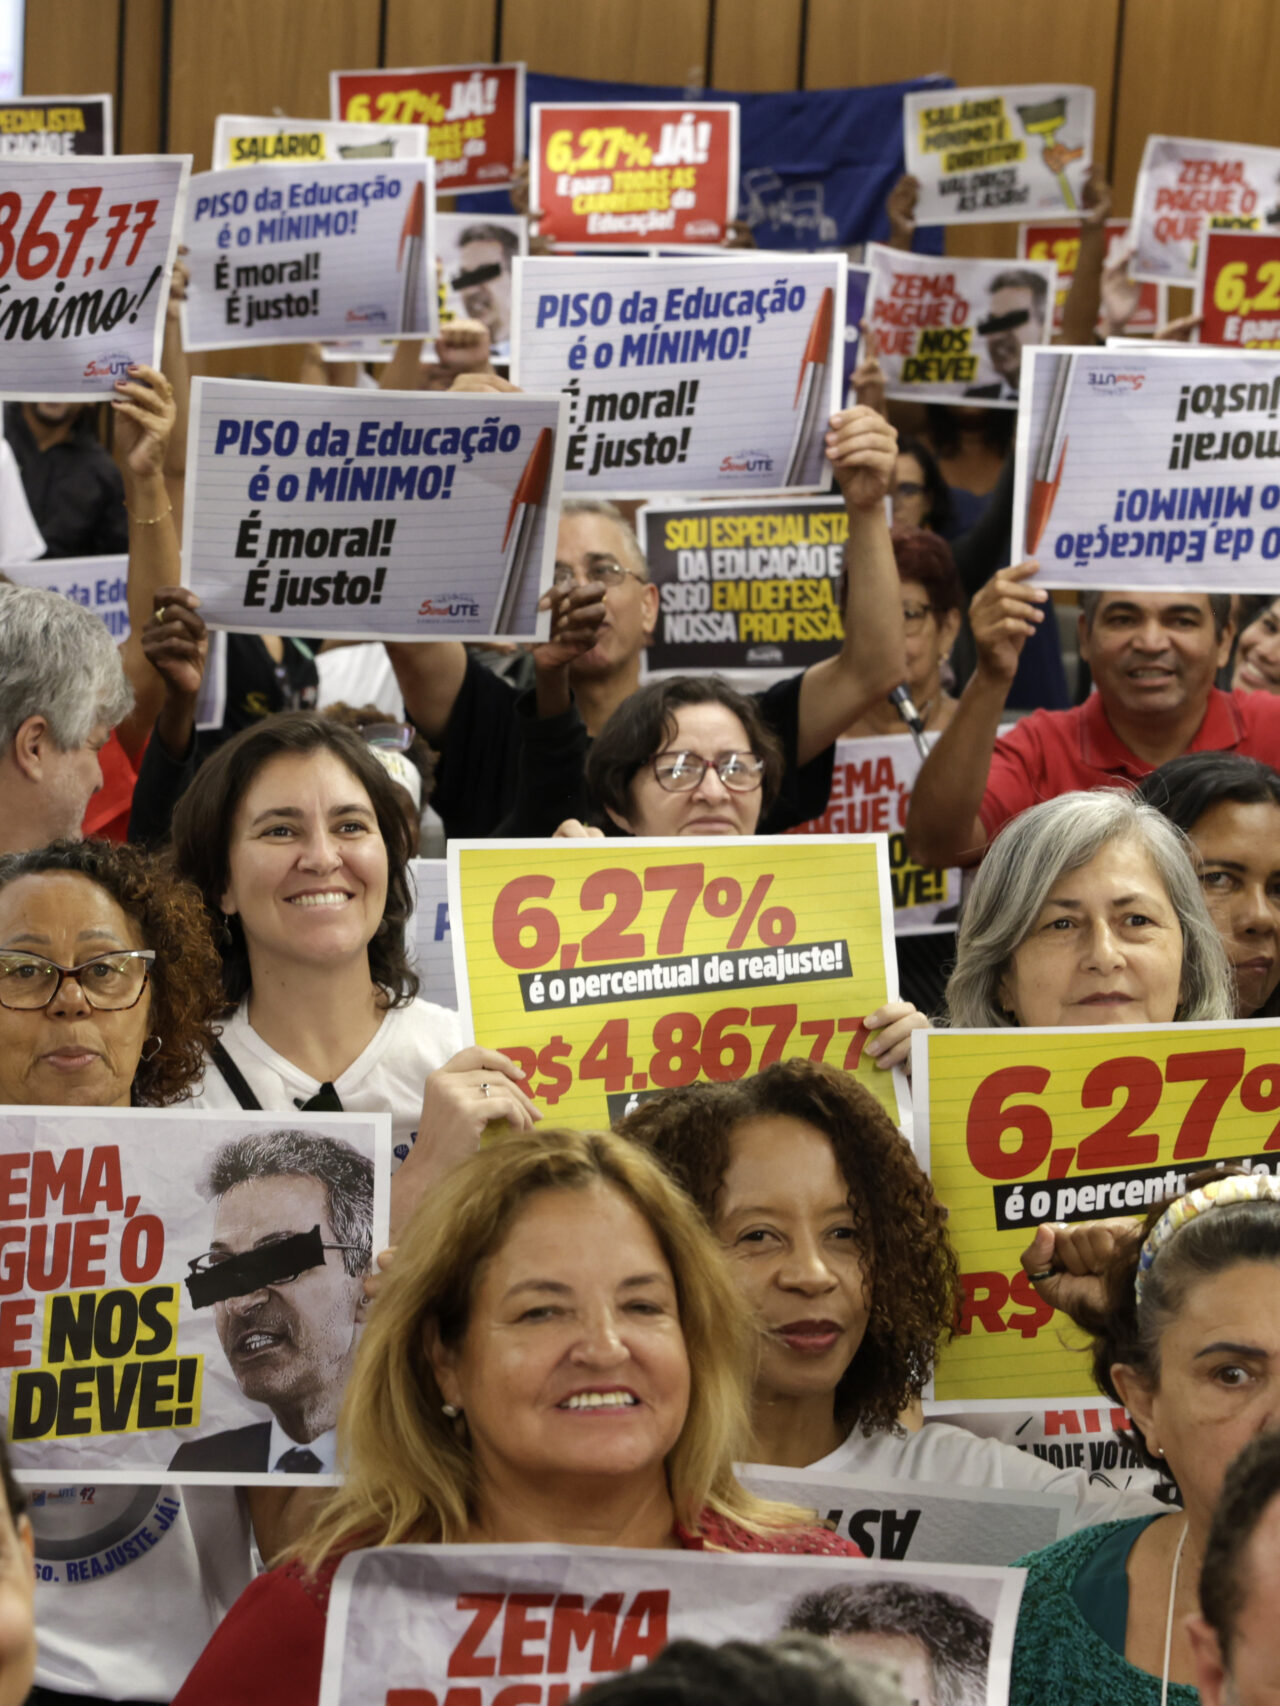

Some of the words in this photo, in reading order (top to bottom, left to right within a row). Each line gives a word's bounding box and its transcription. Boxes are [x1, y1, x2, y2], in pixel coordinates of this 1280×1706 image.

[545, 127, 651, 174] 6,27%
[653, 114, 711, 166] JÁ!
[194, 190, 249, 221] PISO
[254, 186, 282, 213] da
[289, 175, 401, 209] Educação
[1155, 188, 1230, 212] PAGUE
[218, 223, 231, 248] é
[237, 227, 251, 246] o
[257, 208, 358, 245] MÍNIMO!
[1154, 217, 1201, 243] QUE
[214, 255, 228, 290] É
[236, 252, 320, 288] moral!
[891, 273, 961, 300] ZEMA,
[1214, 262, 1280, 315] 6,2
[226, 292, 241, 324] É
[245, 289, 319, 328] justo!
[536, 292, 612, 328] PISO
[620, 291, 658, 324] da
[664, 278, 806, 323] Educação
[873, 300, 949, 327] PAGUE
[568, 336, 587, 370] é
[594, 343, 613, 369] o
[619, 324, 751, 367] MÍNIMO!
[921, 329, 969, 354] NOS
[902, 357, 977, 382] DEVE!
[584, 380, 699, 423] moral!
[215, 419, 299, 456] PISO
[306, 422, 350, 457] da
[356, 416, 521, 463] Educação
[565, 426, 587, 471] É
[589, 427, 691, 476] justo!
[249, 465, 269, 501] é
[277, 473, 299, 501] o
[306, 458, 456, 502] MÍNIMO!
[1114, 486, 1253, 528] MÍNIMO!
[235, 510, 262, 559] É
[266, 518, 396, 558] moral!
[665, 517, 708, 550] SOU
[1055, 524, 1207, 567] Educação
[1214, 527, 1254, 561] da
[678, 550, 710, 581] DA
[712, 541, 825, 581] EDUCAÇÃO
[827, 547, 842, 576] E
[244, 560, 269, 607] É
[270, 567, 387, 613] justo!
[662, 584, 710, 611] SIGO
[713, 582, 748, 611] EM
[751, 579, 834, 610] DEFESA
[665, 615, 737, 644] NOSSA
[739, 605, 845, 642] PROFISSÃ
[832, 756, 904, 801] EMA,
[892, 868, 945, 907] VE!
[493, 862, 796, 970] 6,27%
[529, 973, 545, 1003] é
[550, 978, 566, 1002] o
[570, 957, 699, 1004] percentual
[705, 954, 732, 983] de
[738, 942, 843, 983] reajuste!
[1005, 1185, 1024, 1221] é
[1030, 1194, 1050, 1218] o
[120, 1215, 164, 1283] O
[48, 1286, 174, 1362] NOS
[12, 1358, 198, 1440] DEVE!
[66, 1527, 158, 1583] REAJUSTE
[154, 1497, 180, 1531] JÁ!
